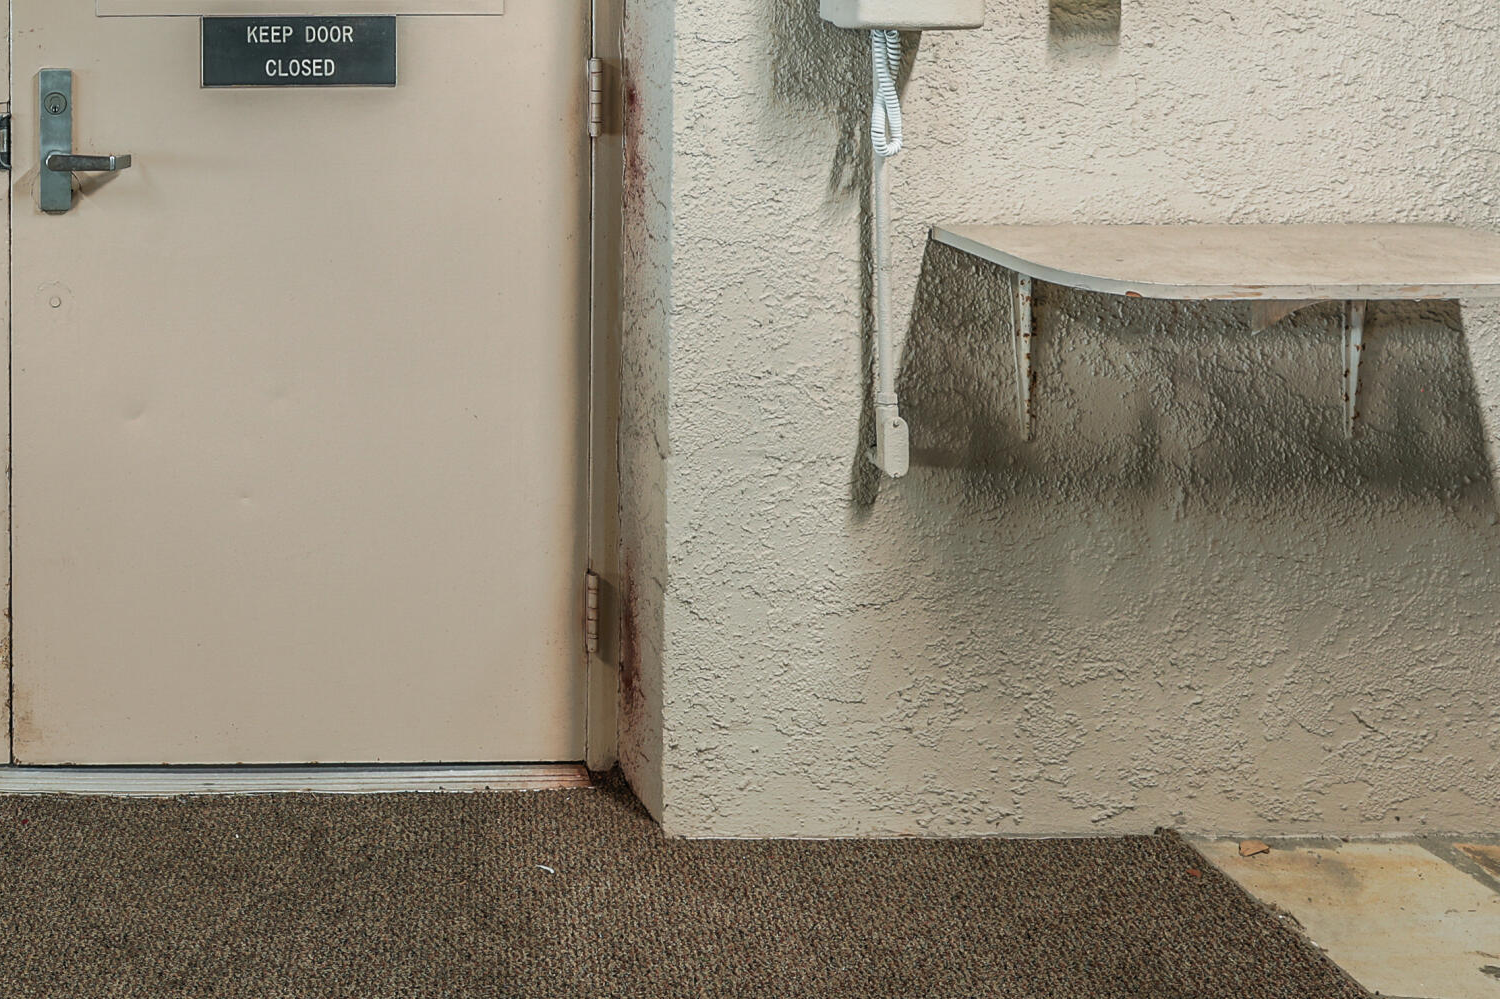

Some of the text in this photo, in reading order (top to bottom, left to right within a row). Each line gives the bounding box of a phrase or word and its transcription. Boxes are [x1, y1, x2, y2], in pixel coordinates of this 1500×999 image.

[247, 26, 353, 43] KEEP DOOR
[265, 59, 335, 77] CLOSED
